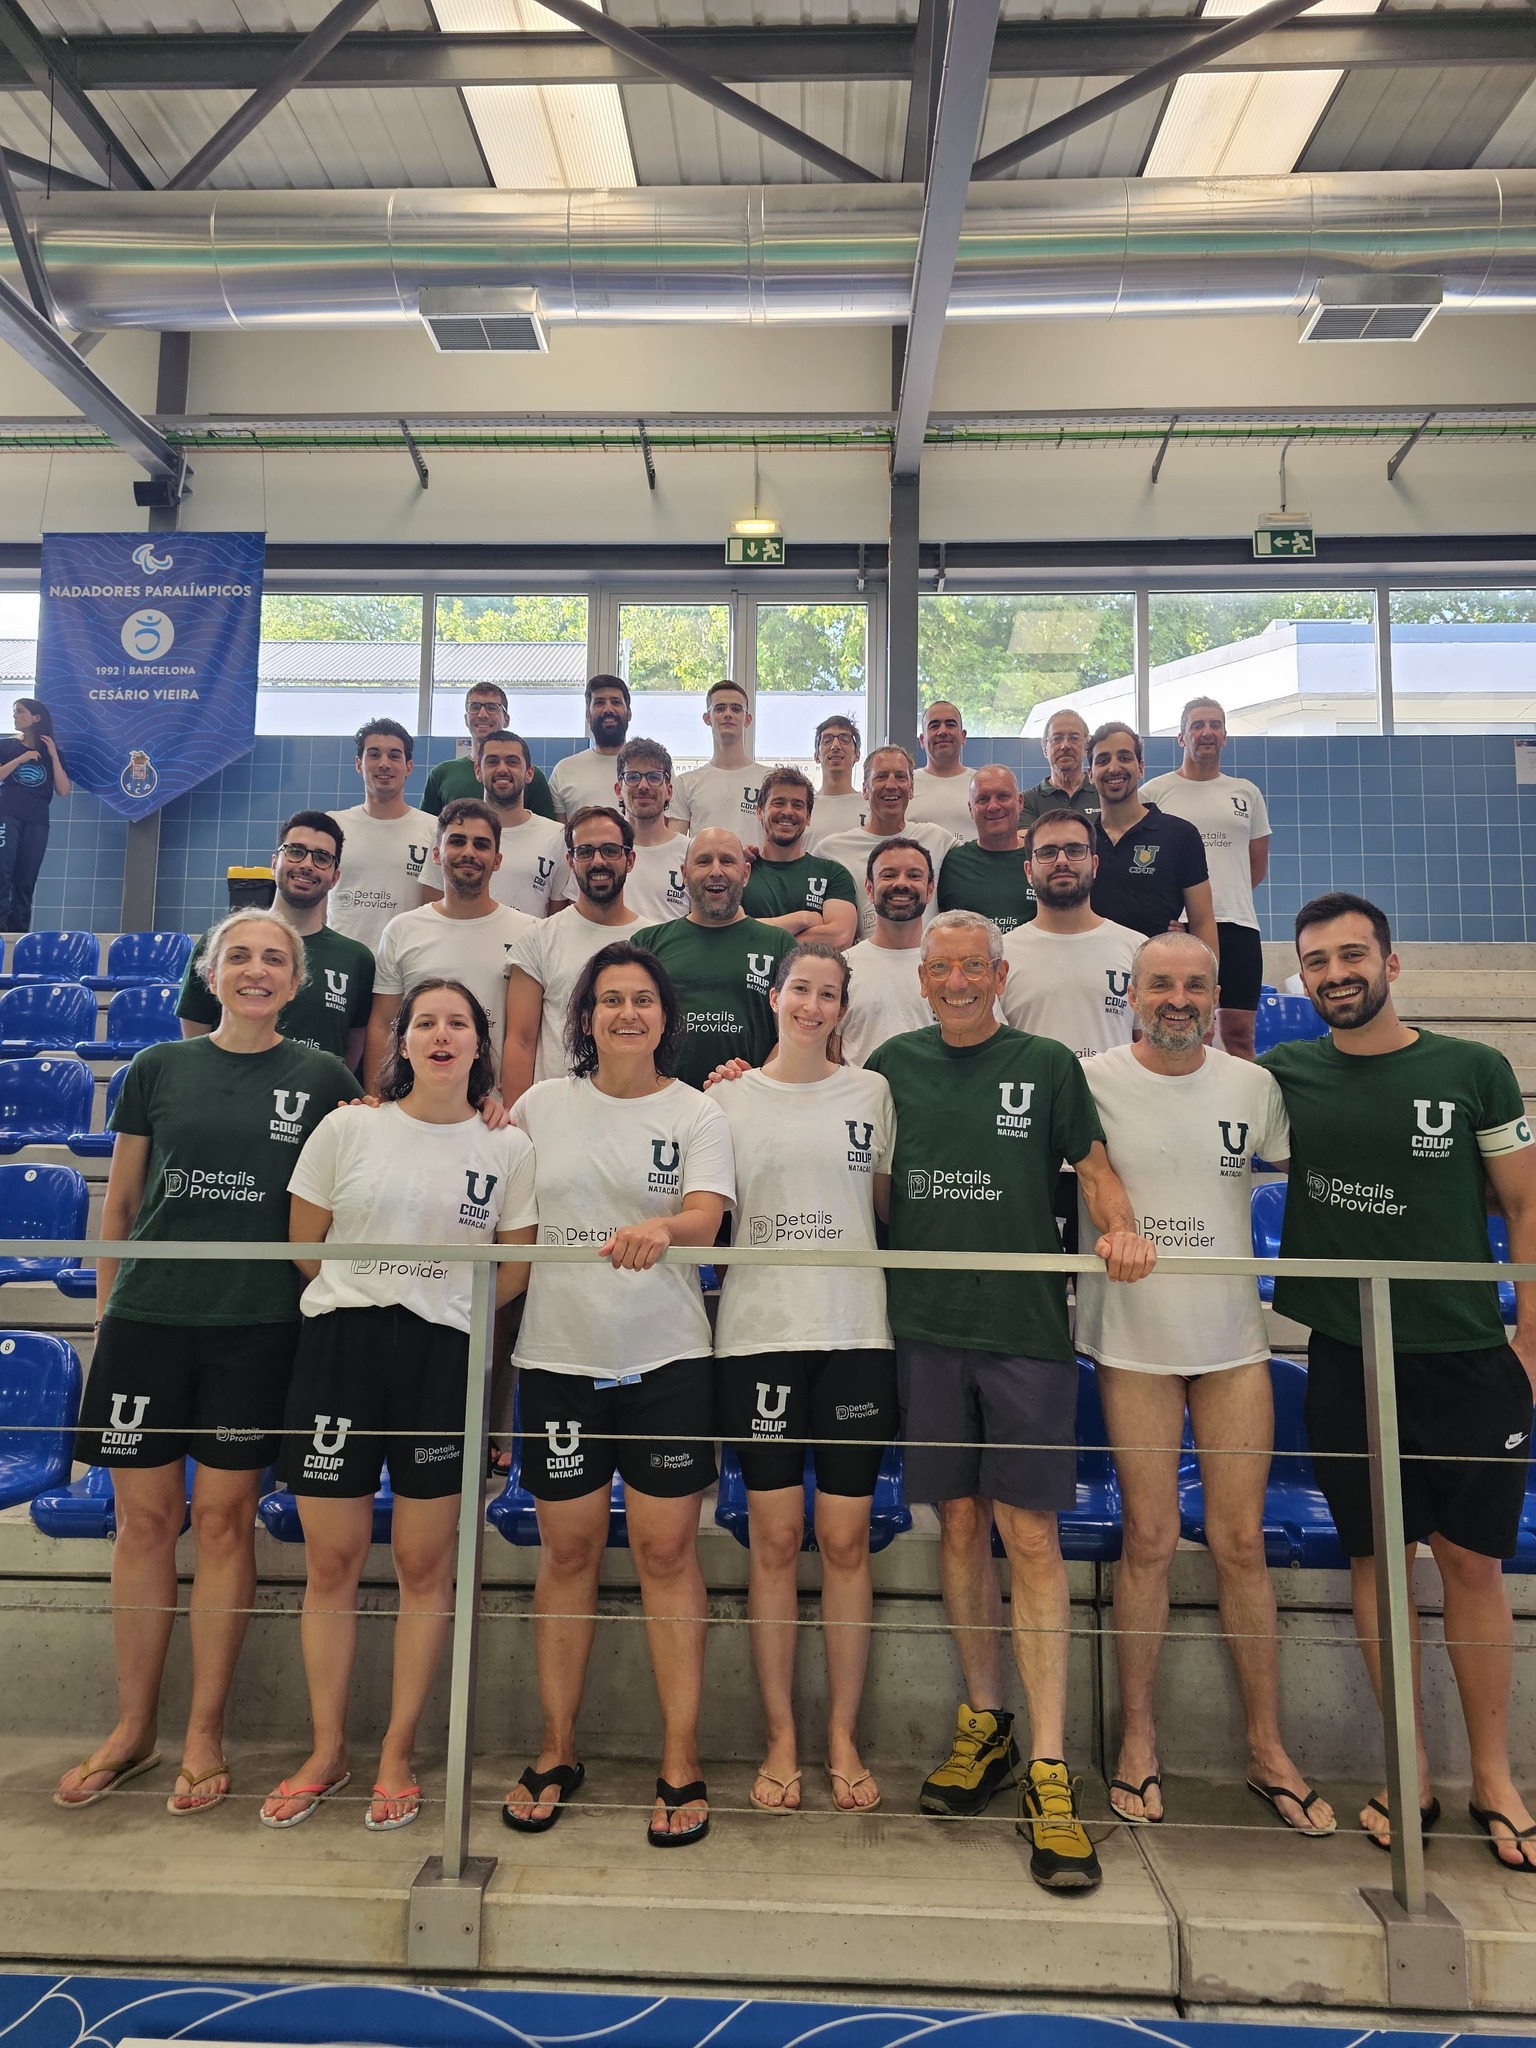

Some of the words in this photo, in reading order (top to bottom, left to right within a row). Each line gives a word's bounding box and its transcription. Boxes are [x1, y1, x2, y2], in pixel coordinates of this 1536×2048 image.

[50, 585, 140, 598] NADADORES
[145, 582, 252, 598] PARALÍMPICOS
[96, 666, 119, 675] 1992
[129, 666, 196, 676] BARCELONA
[88, 686, 150, 701] CESÁRIO
[154, 688, 200, 700] VIEIRA
[1200, 832, 1226, 840] etails
[1203, 840, 1232, 848] ovider
[408, 844, 428, 865] U
[406, 863, 423, 873] CDU
[537, 856, 555, 879] U
[354, 890, 391, 900] Details
[807, 877, 828, 897] U
[353, 899, 398, 909] Provider
[746, 953, 775, 978] U
[324, 968, 349, 995] U
[1105, 970, 1131, 998] U
[686, 1011, 735, 1022] Details
[686, 1022, 744, 1033] Provider
[273, 1089, 311, 1122] U
[999, 1082, 1035, 1115] U
[1413, 1099, 1456, 1136] U
[845, 1120, 874, 1151] U
[1218, 1120, 1249, 1155] U
[651, 1139, 680, 1172] U
[28, 1172, 34, 1180] 7
[191, 1169, 256, 1187] Details
[933, 1169, 991, 1185] Details
[189, 1185, 266, 1202] Provider
[465, 1169, 498, 1207] U
[932, 1185, 1003, 1201] Provider
[1331, 1178, 1395, 1200] Details
[1330, 1192, 1407, 1217] Provider
[775, 1210, 833, 1227] Details
[1143, 1216, 1205, 1231] Details
[775, 1225, 844, 1243] Provider
[1143, 1231, 1215, 1248] Provider
[378, 1261, 449, 1280] Provider
[4, 1342, 11, 1351] 8
[756, 1381, 791, 1419] U
[849, 1402, 874, 1412] Details
[109, 1392, 150, 1430] U
[850, 1407, 880, 1419] Provider
[229, 1433, 264, 1442] Provider
[312, 1414, 352, 1455] U
[545, 1420, 582, 1456] U
[428, 1444, 455, 1456] Details
[428, 1450, 461, 1463] Provider
[664, 1452, 690, 1462] Details
[664, 1459, 694, 1469] Provider
